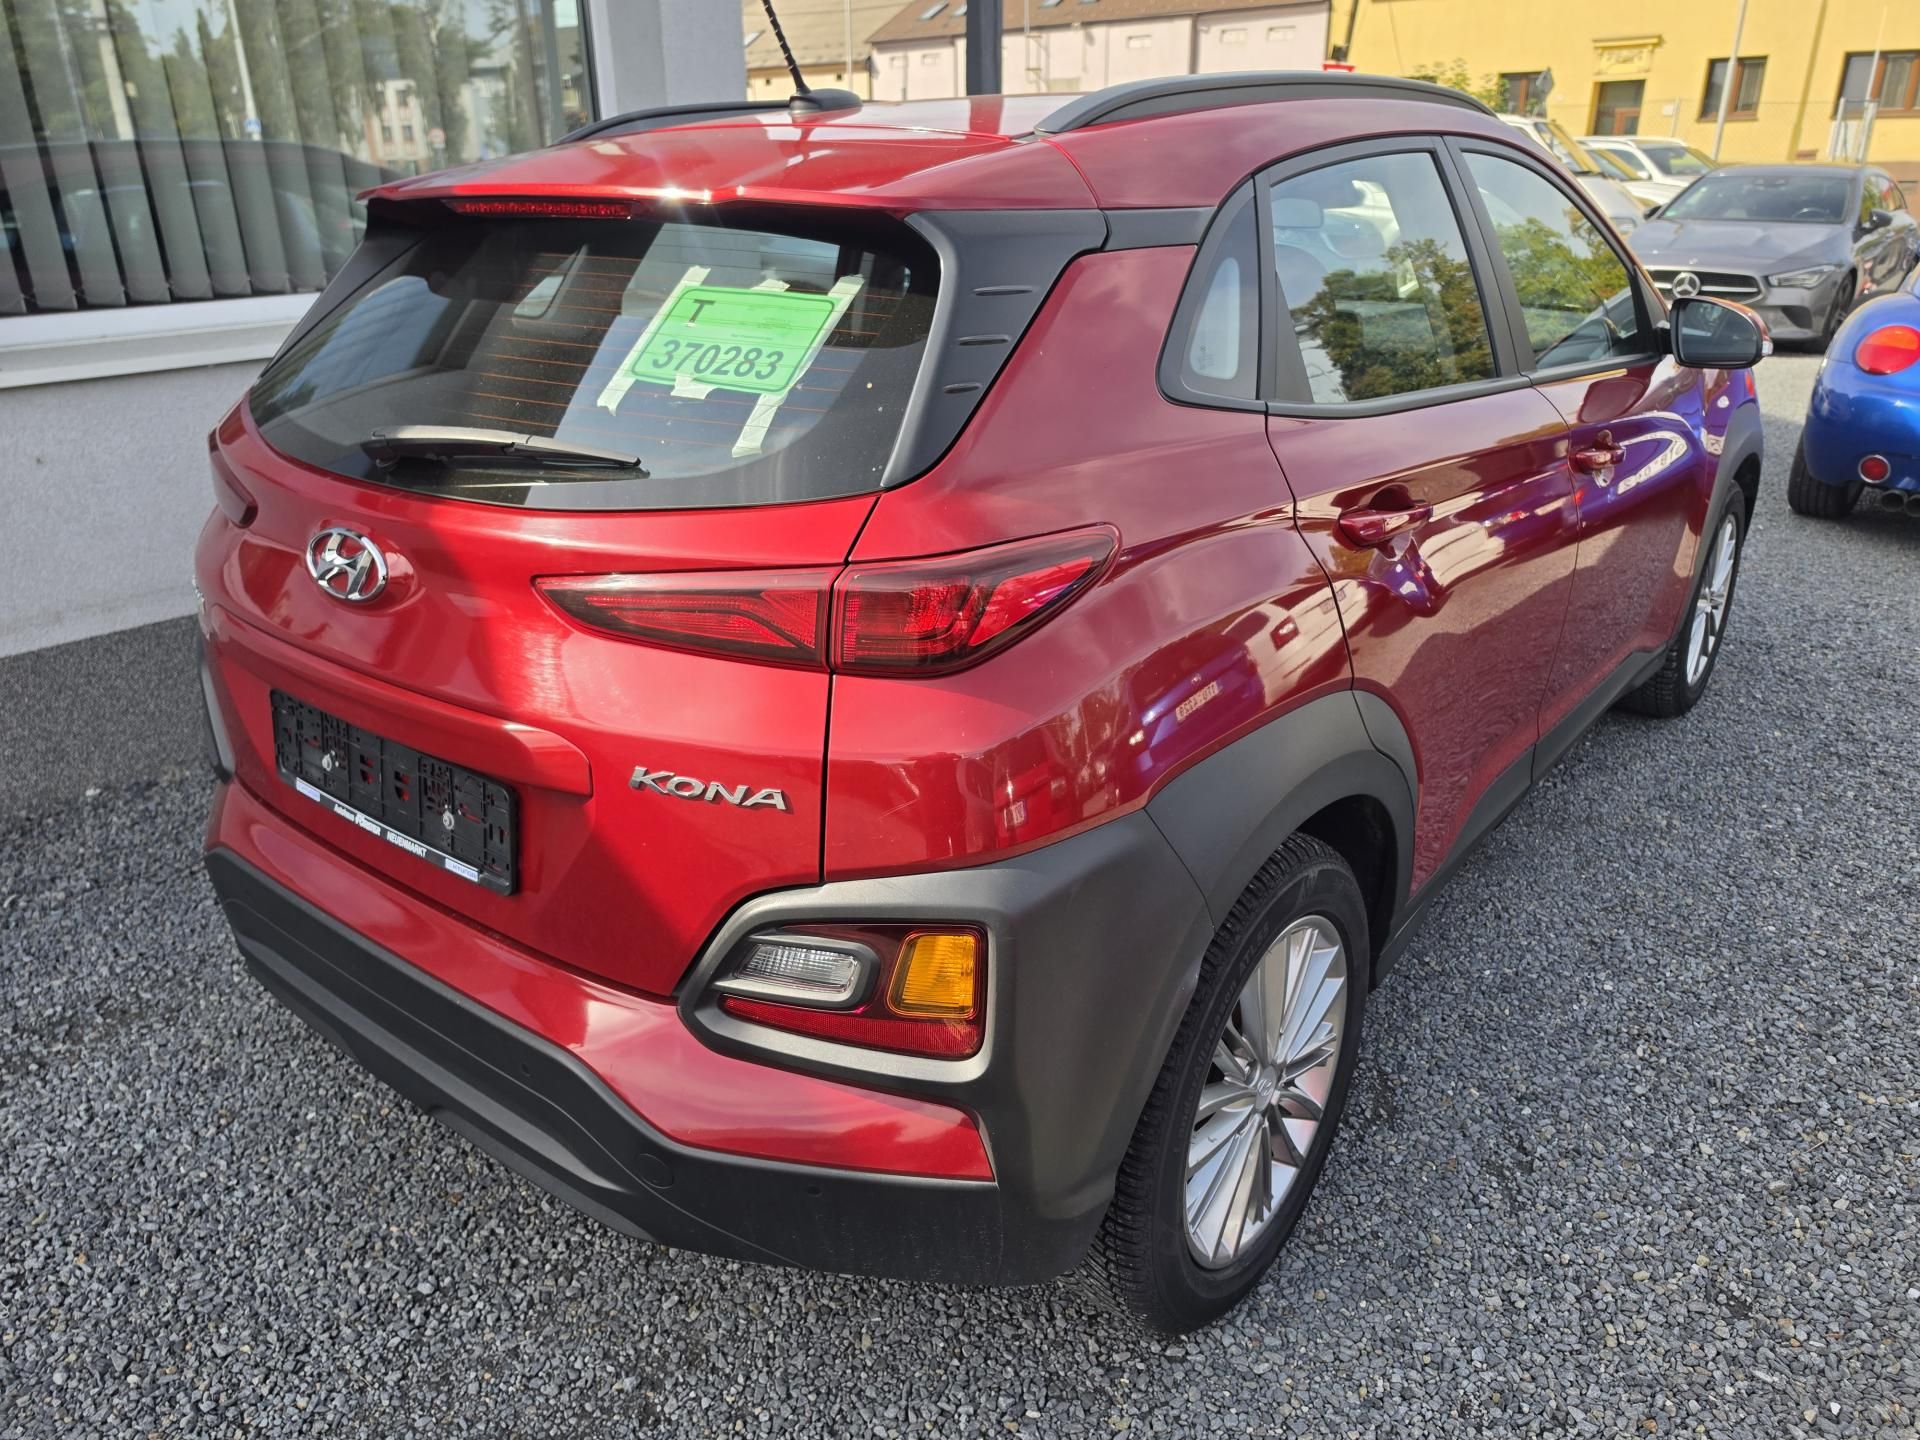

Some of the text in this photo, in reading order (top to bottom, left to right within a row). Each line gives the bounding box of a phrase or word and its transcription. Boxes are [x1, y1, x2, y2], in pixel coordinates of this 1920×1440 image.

[690, 299, 715, 323] T
[652, 339, 784, 380] 370283
[629, 765, 790, 811] KONA
[387, 831, 427, 857] NEUENMARKT
